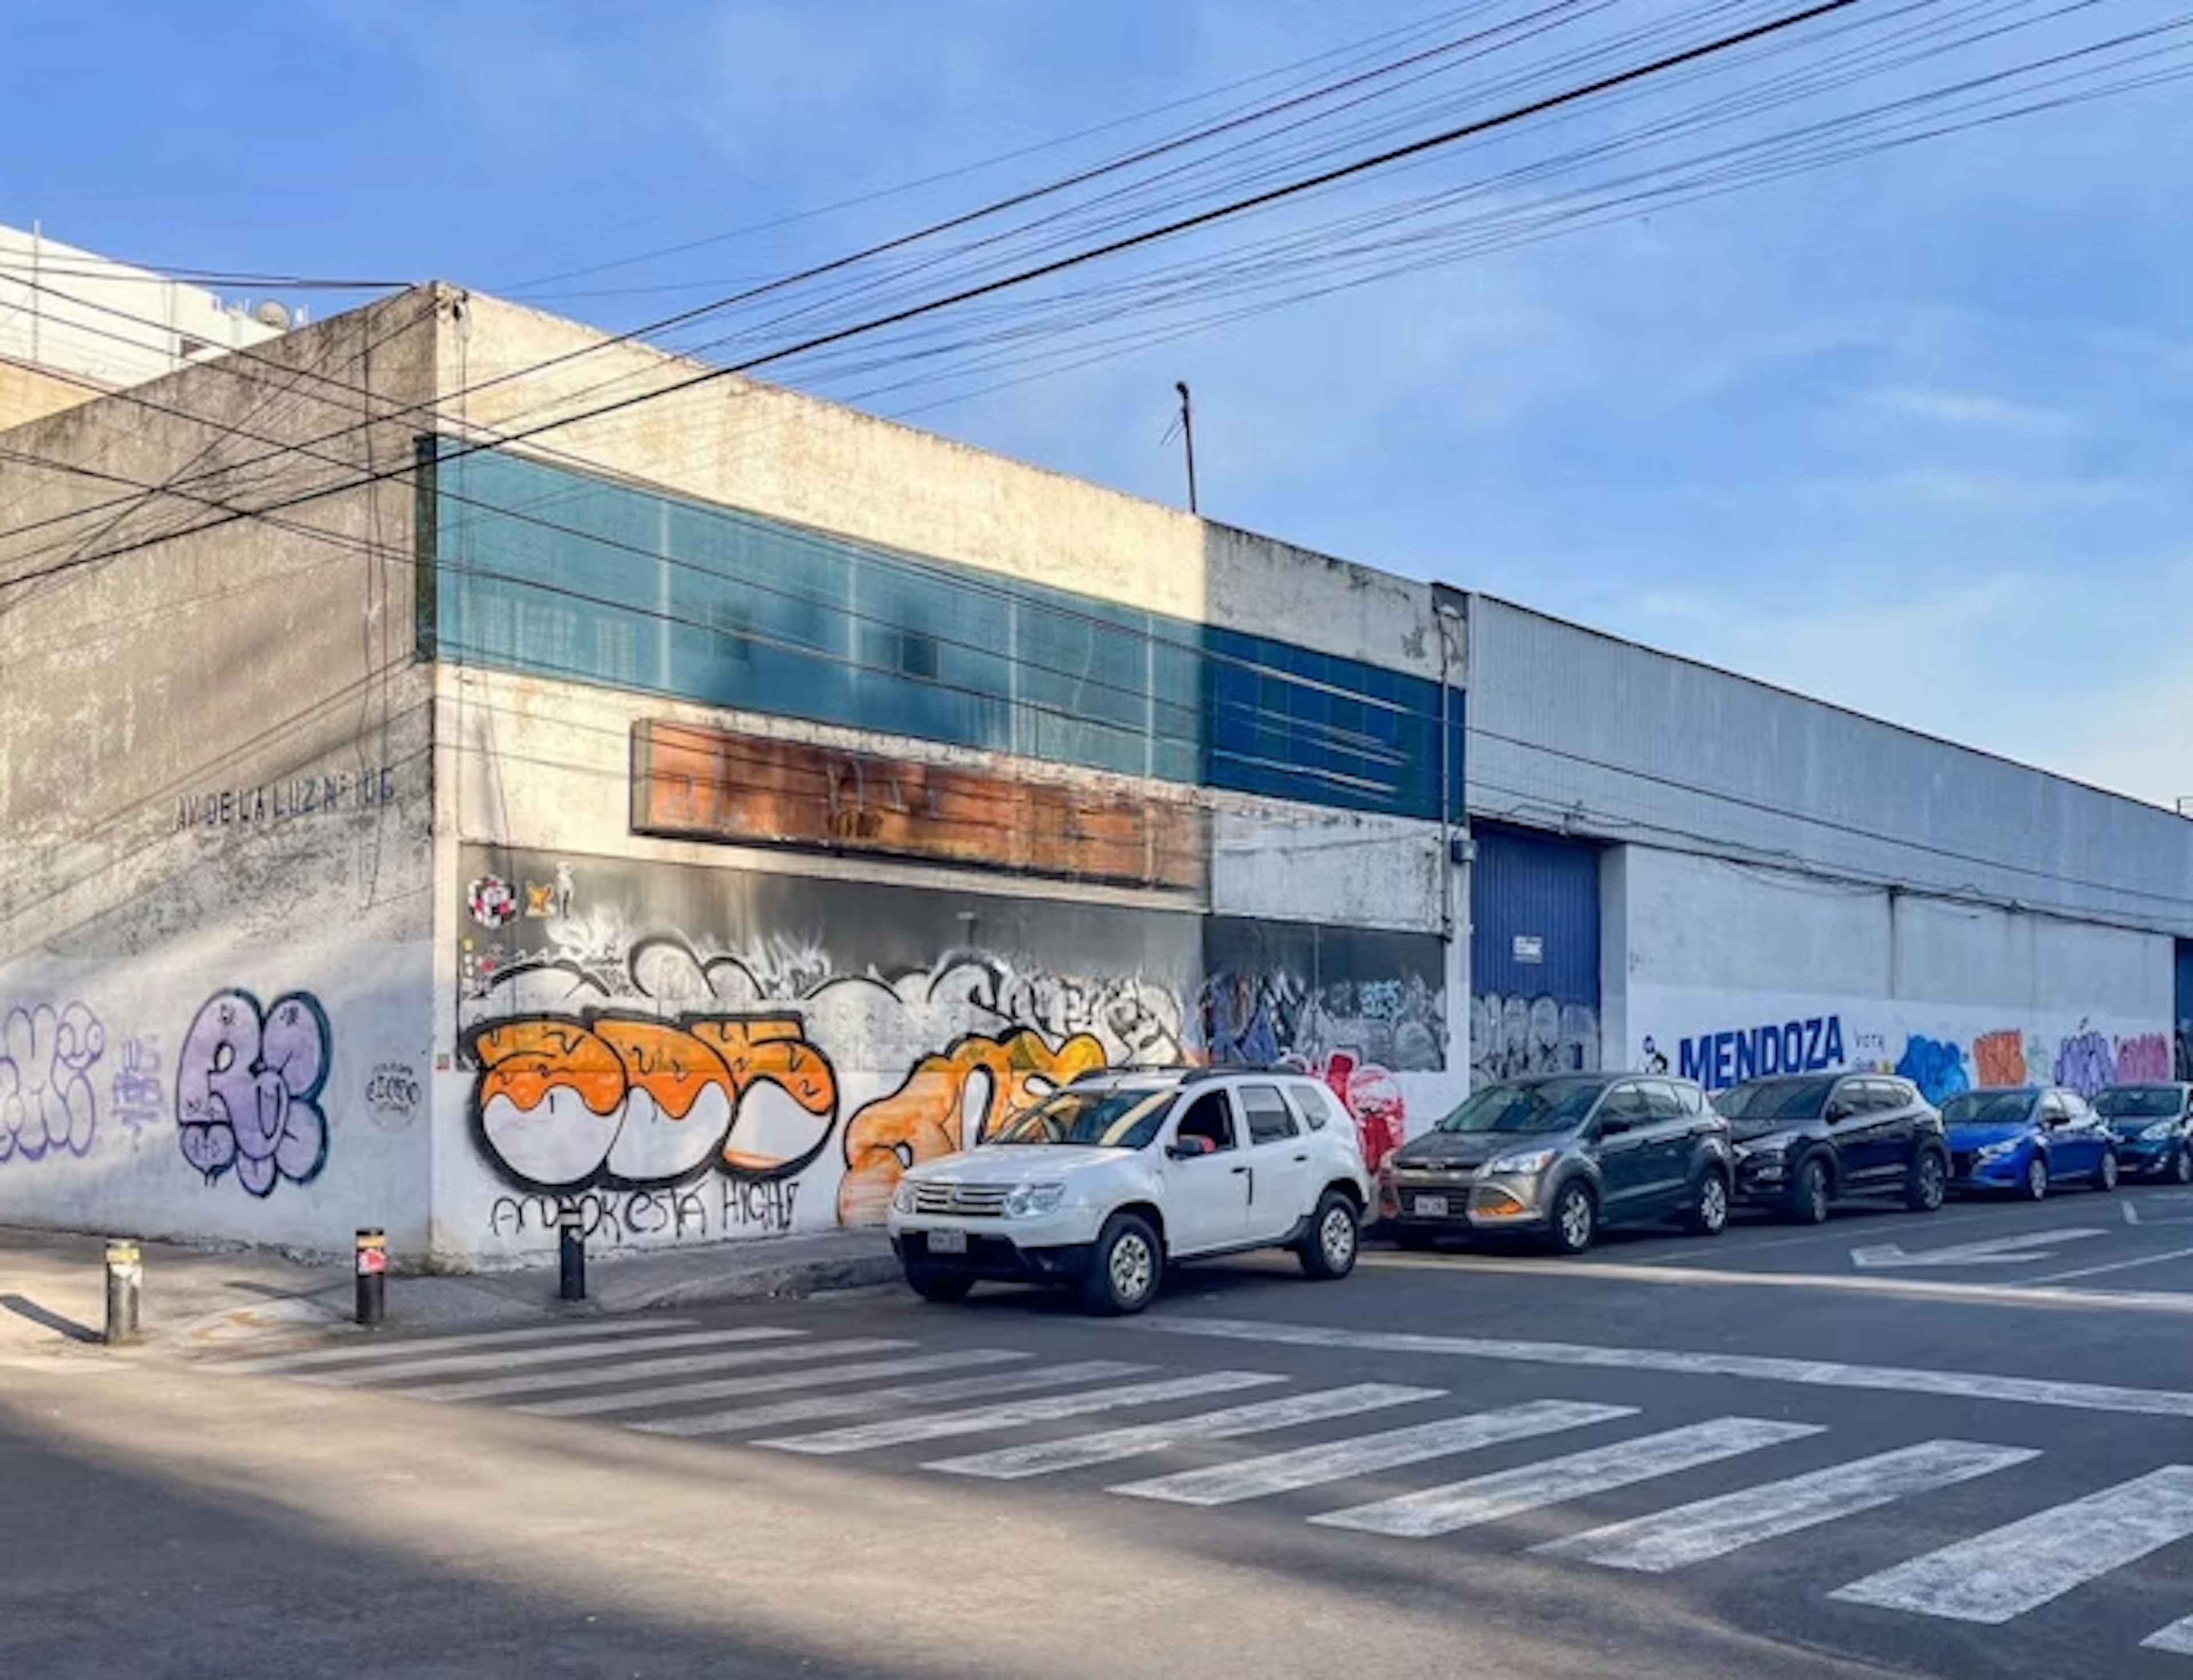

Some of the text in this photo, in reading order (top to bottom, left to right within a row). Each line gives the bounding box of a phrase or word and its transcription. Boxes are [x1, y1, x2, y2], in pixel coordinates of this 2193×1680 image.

[206, 791, 230, 825] DE
[238, 787, 264, 822] LA
[273, 779, 316, 817] LUZ
[1680, 1015, 1844, 1091] MENDOZA
